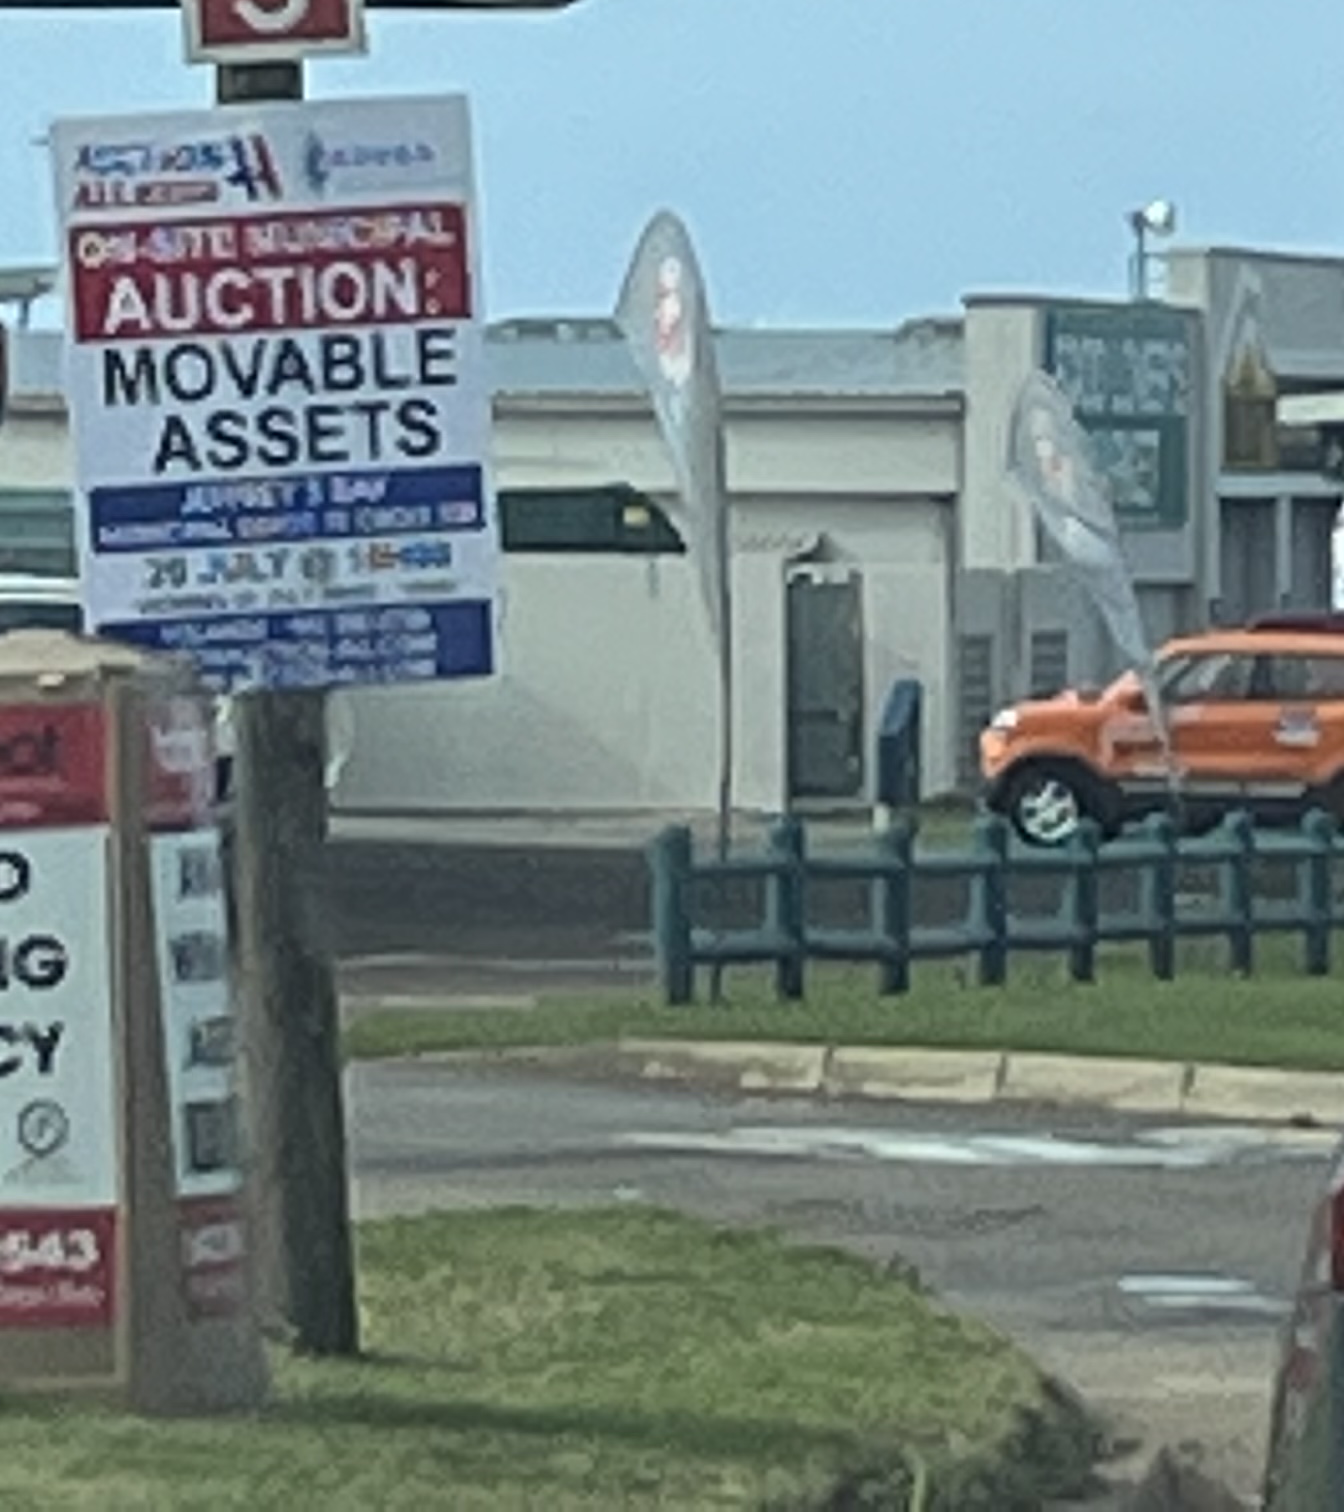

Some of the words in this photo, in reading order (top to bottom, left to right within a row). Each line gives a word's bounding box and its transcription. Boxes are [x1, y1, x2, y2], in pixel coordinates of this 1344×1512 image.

[102, 256, 441, 335] AUCTION:
[103, 327, 458, 407] MOVABLE
[153, 398, 442, 474] ASSETS
